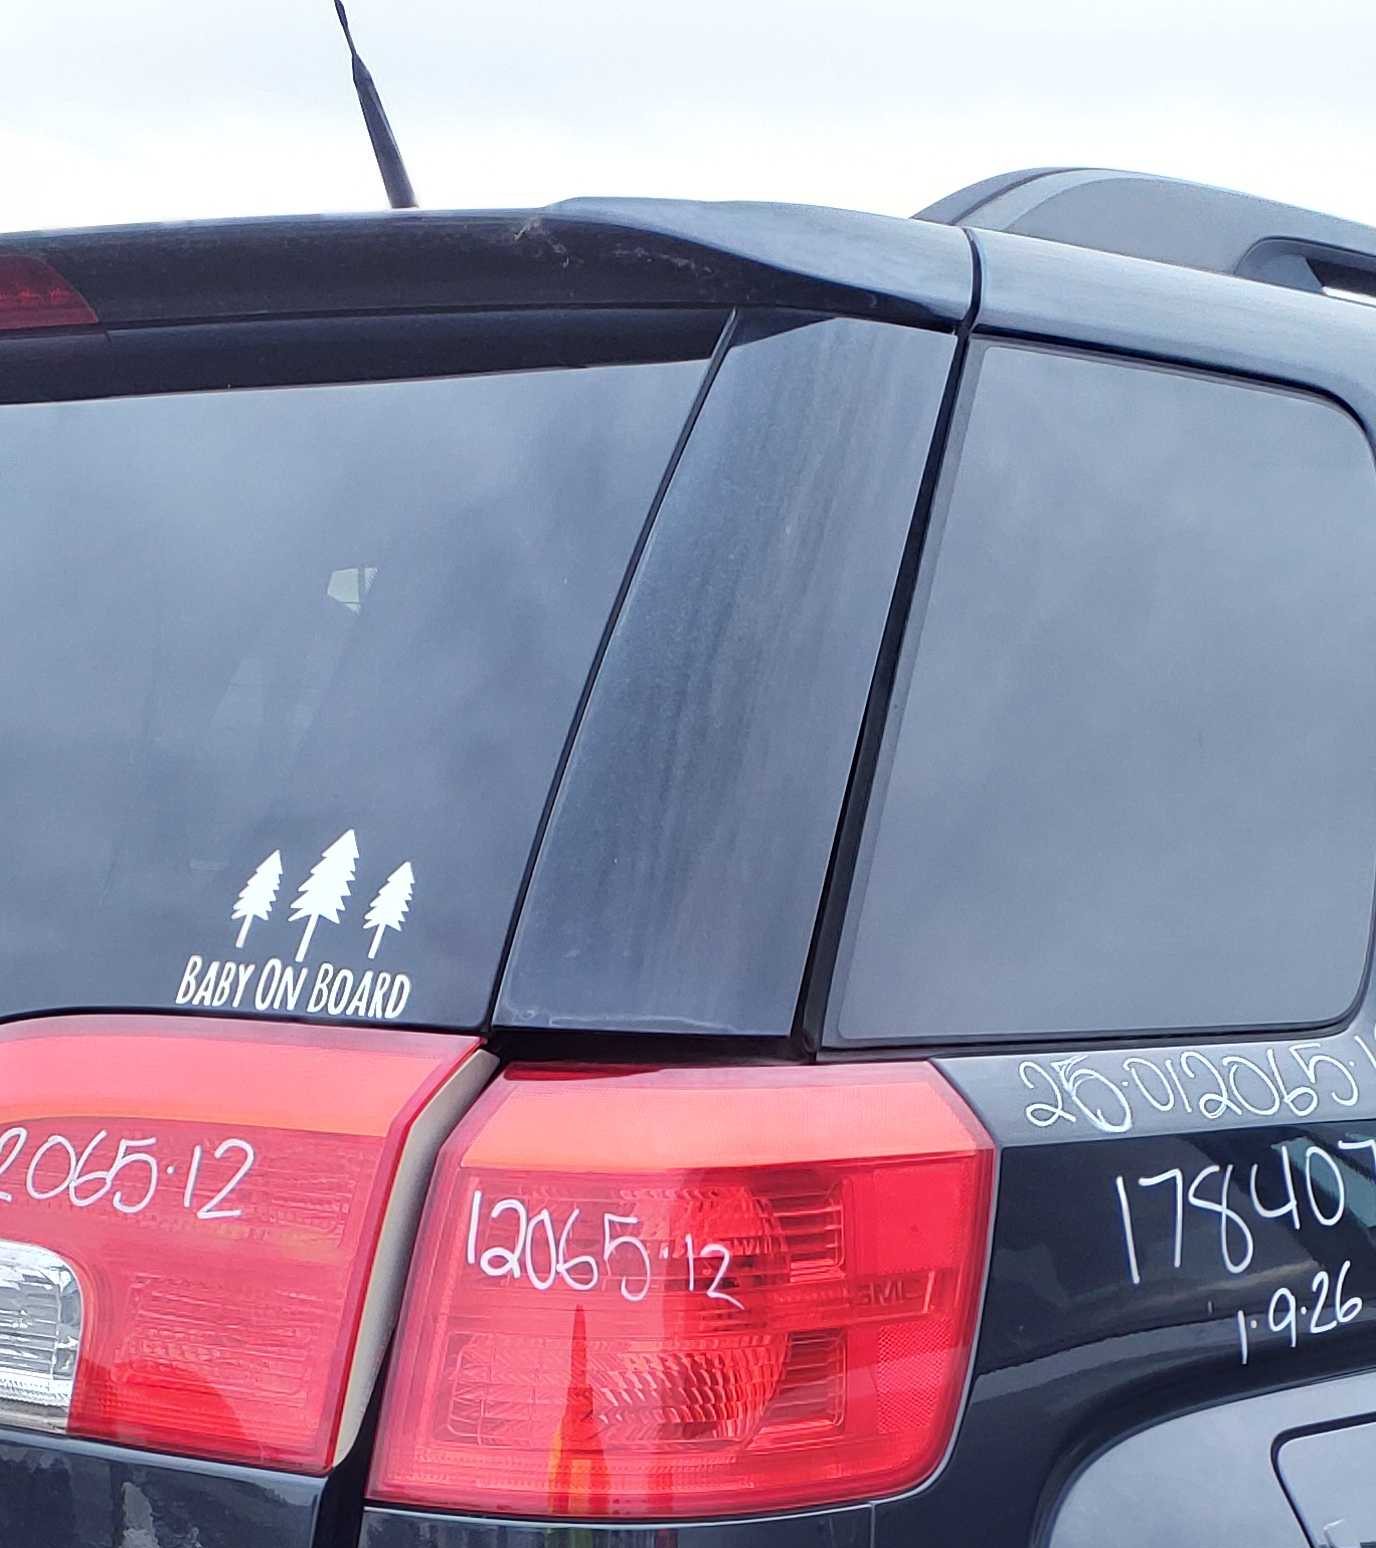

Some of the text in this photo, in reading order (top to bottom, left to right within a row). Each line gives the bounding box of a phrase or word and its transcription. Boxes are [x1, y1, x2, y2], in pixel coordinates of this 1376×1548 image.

[175, 954, 412, 1020] BABY ON BOARD
